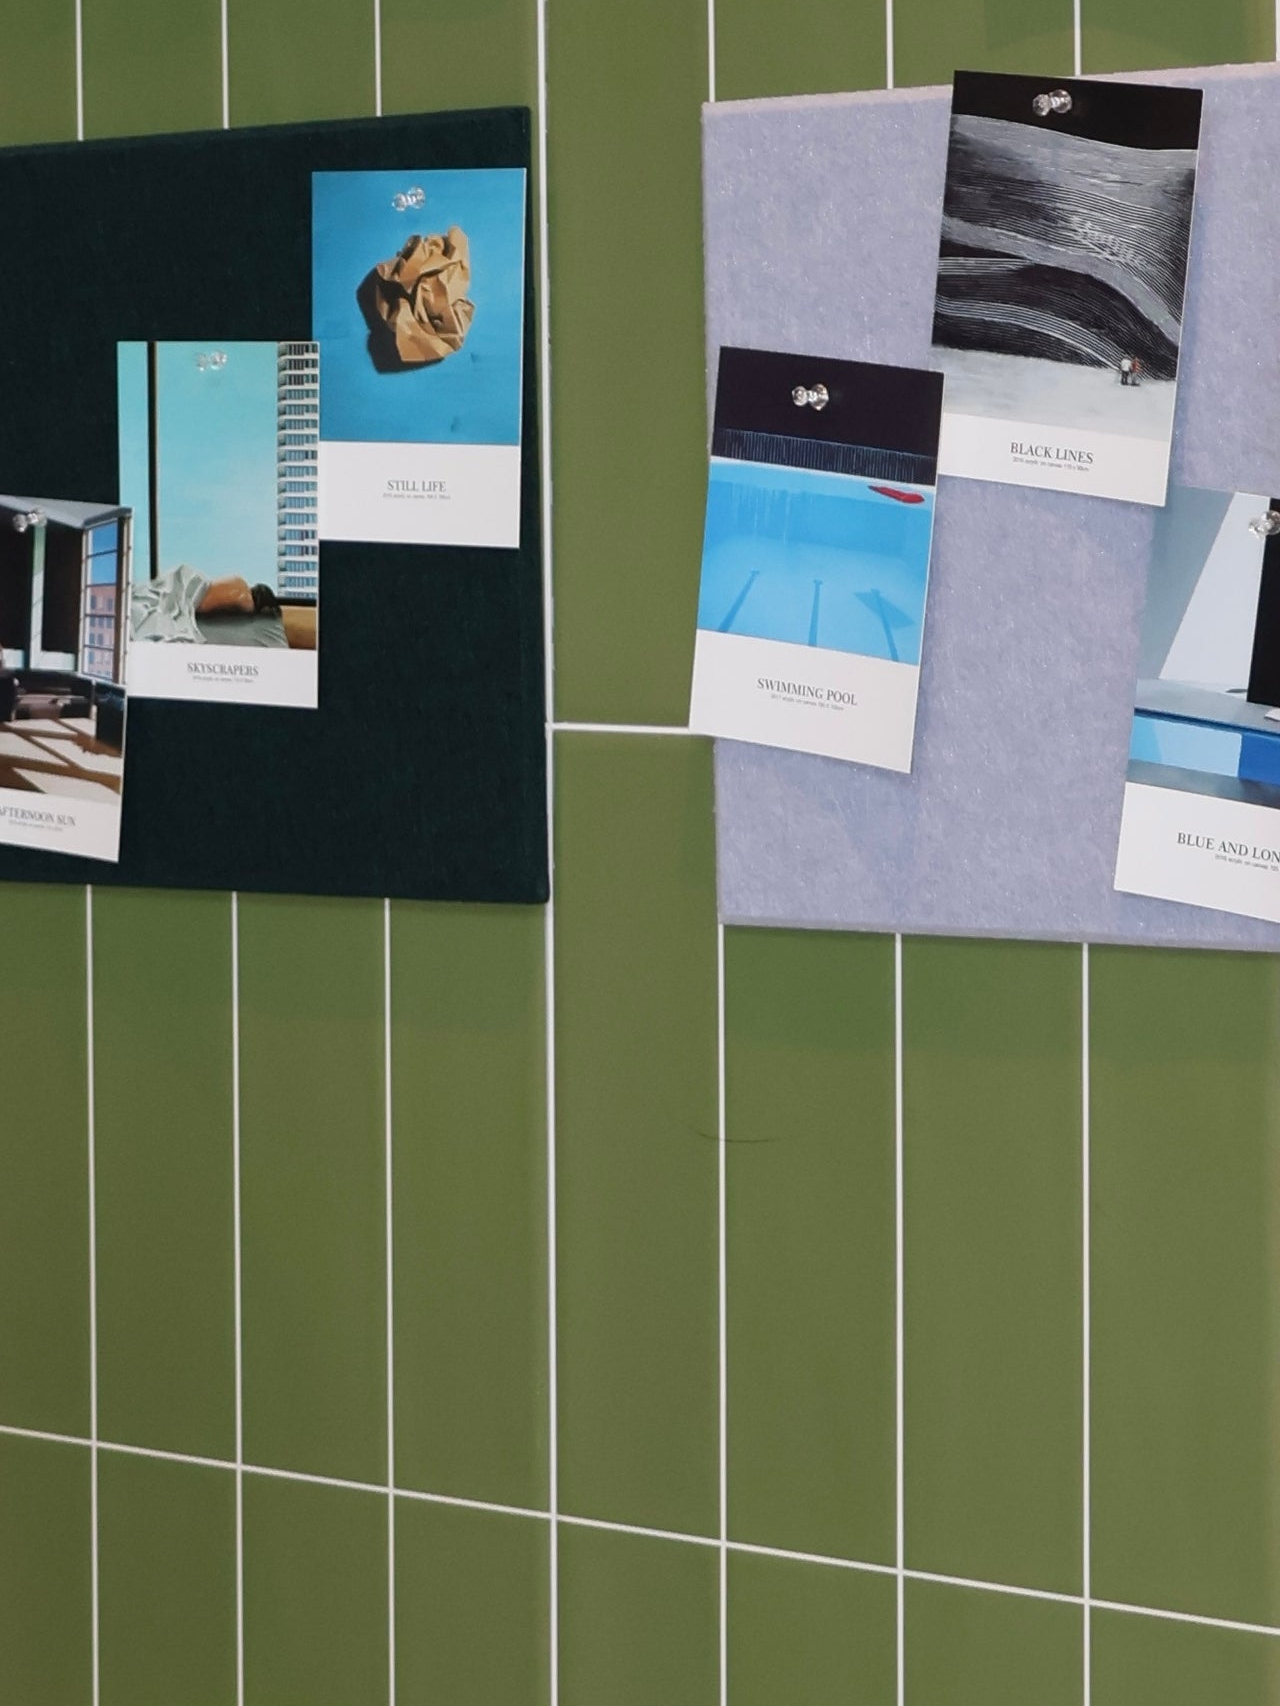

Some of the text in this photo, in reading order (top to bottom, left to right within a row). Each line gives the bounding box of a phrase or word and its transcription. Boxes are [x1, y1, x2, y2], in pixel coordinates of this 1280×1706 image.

[1010, 441, 1053, 459] BLACK
[1055, 447, 1094, 464] LINES
[387, 479, 446, 493] STILL LIFE
[187, 662, 259, 676] SKYSCRAPERS
[757, 677, 824, 699] SWIMMING
[826, 688, 858, 706] POOL
[1177, 832, 1215, 850] BLUE
[1218, 840, 1249, 856] AND
